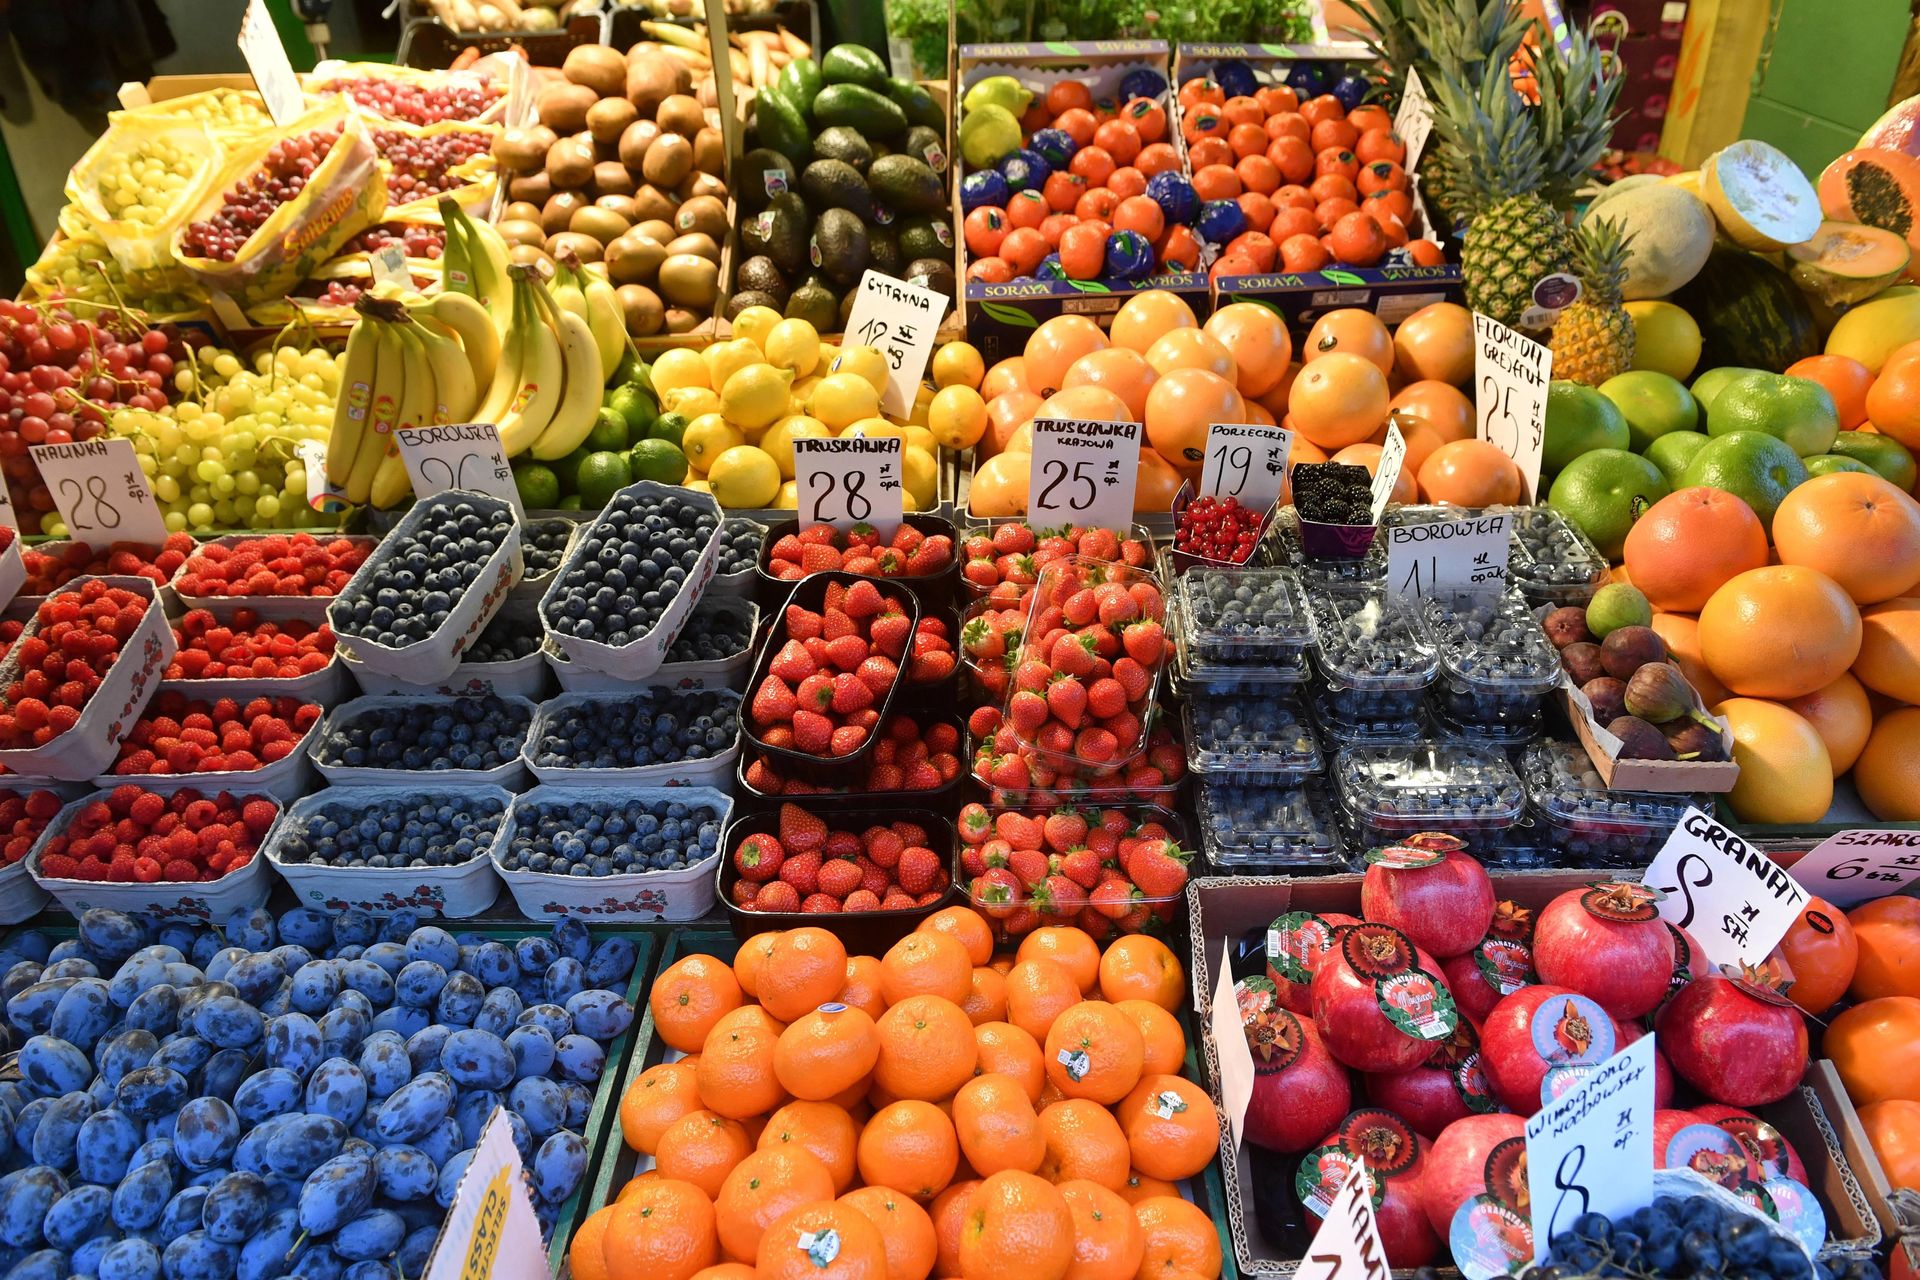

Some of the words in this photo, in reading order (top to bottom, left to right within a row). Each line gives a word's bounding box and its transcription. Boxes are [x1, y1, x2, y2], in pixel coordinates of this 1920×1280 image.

[1191, 46, 1248, 57] SORAYA
[867, 277, 930, 312] CYTRYNA
[984, 285, 1050, 298] SORAYA
[1237, 275, 1304, 290] SORAYA
[1475, 315, 1543, 367] FLORIDA
[1034, 419, 1137, 440] TRUSKAWKA
[1057, 437, 1114, 449] KRAJOWA
[1212, 425, 1287, 442] PORZECZKA
[33, 441, 108, 463] MALINKA
[792, 438, 901, 454] TRUSKAWKA
[1037, 460, 1096, 510] 25
[1213, 445, 1252, 497] 19
[59, 475, 121, 530] 28
[808, 470, 872, 522] 28
[1394, 517, 1504, 544] BOROWKA
[1684, 815, 1803, 906] GRANAT
[1826, 857, 1869, 880] 6
[469, 1189, 497, 1274] CLASS
[479, 1195, 506, 1280] SELECTE
[1480, 1205, 1534, 1245] GRANATAPFEL
